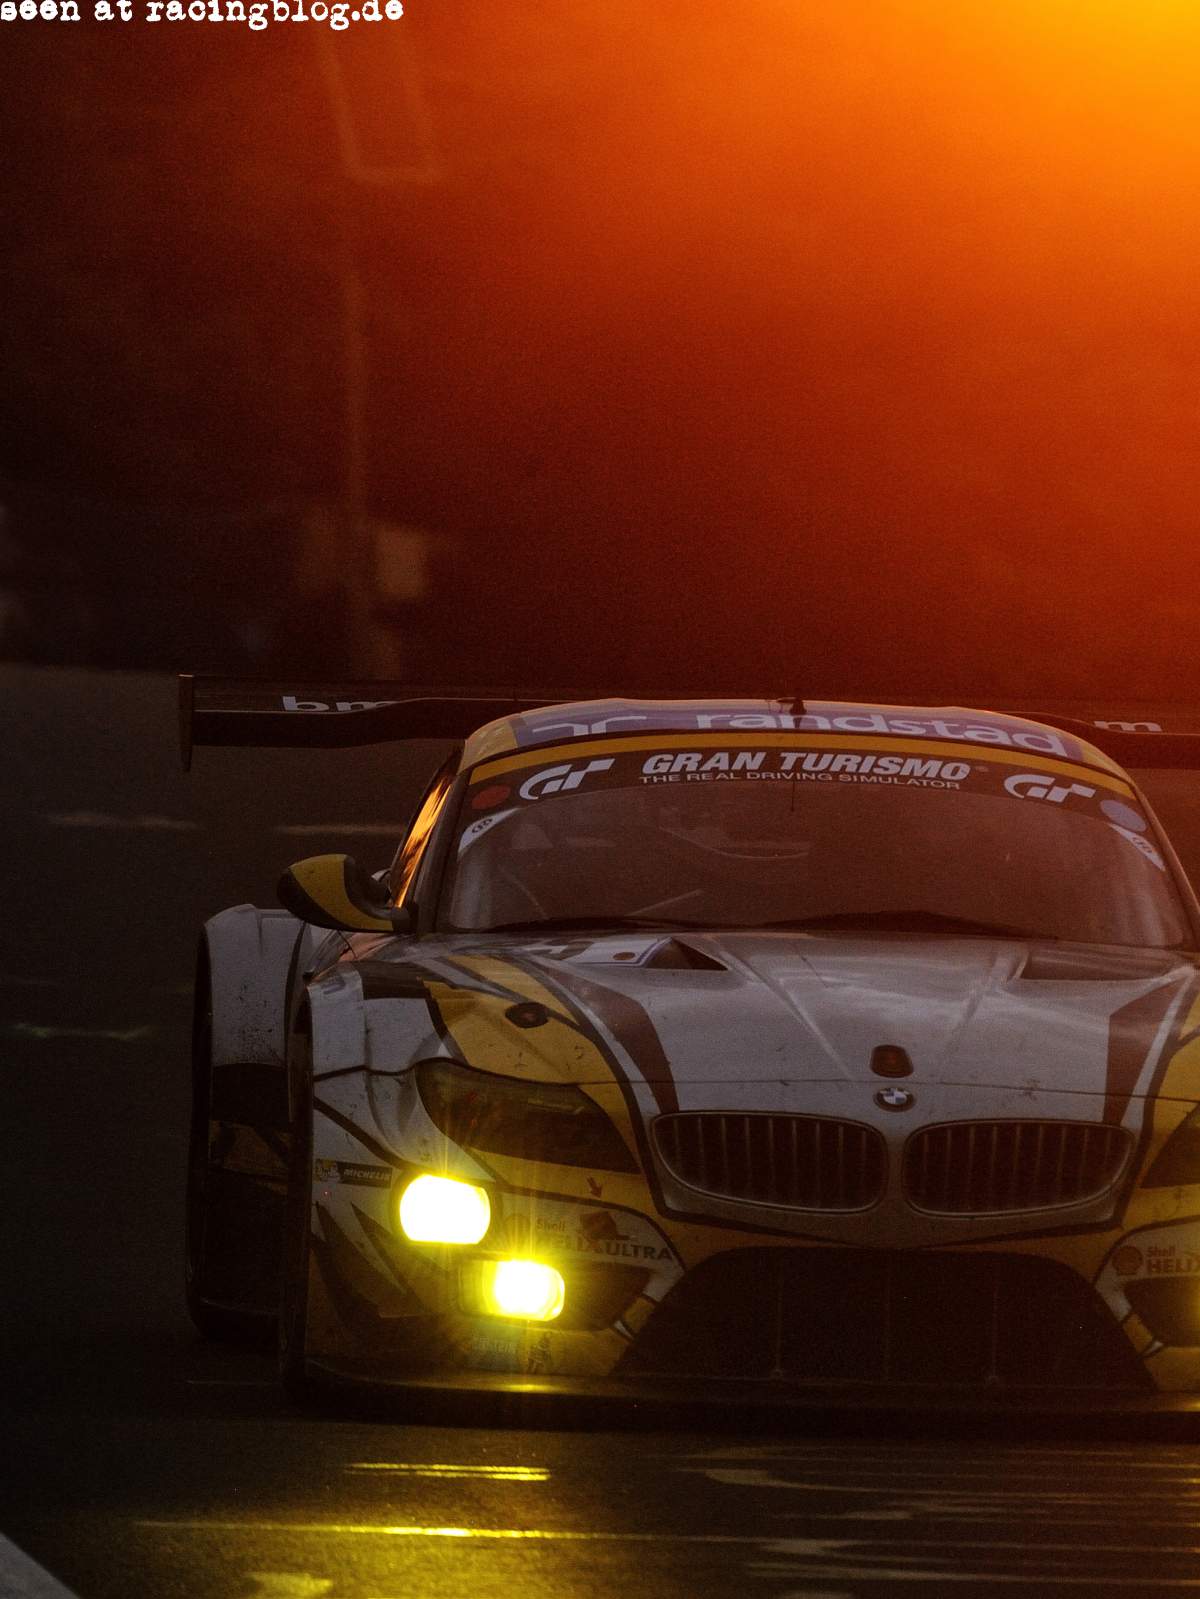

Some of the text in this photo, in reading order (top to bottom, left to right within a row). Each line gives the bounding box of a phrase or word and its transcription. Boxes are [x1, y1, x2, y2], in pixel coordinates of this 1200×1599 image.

[695, 713, 1069, 757] randstad
[641, 751, 972, 781] GRAN TURISMO
[638, 771, 961, 791] THE REAL DRIVING SIMULATOR
[606, 1240, 674, 1261] ULTRA
